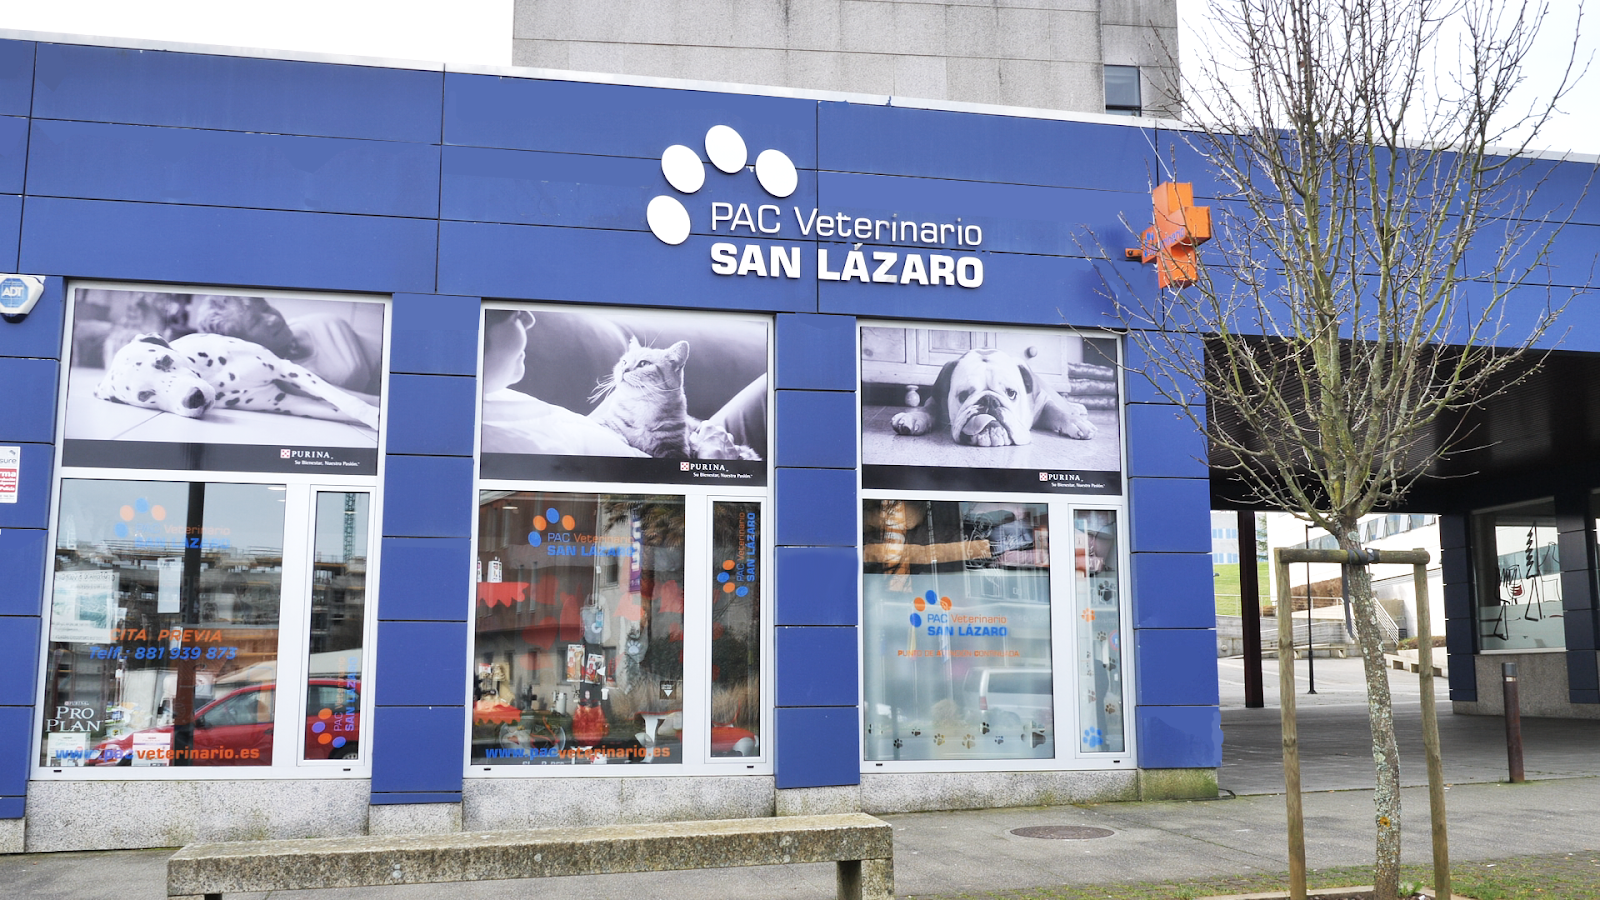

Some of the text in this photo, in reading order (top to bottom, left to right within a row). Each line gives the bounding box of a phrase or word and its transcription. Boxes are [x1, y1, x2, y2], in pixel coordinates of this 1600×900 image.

[711, 202, 983, 247] PAC Veterinario
[711, 242, 984, 288] SAN LÁZARO
[2, 286, 23, 297] ADT
[291, 450, 330, 458] PURINA
[690, 463, 725, 471] PURINA
[1048, 473, 1080, 481] PURINA
[164, 524, 231, 536] Veterinario
[134, 537, 166, 548] SAN
[547, 532, 635, 544] PAC Veterinario
[547, 543, 636, 557] SAN LÁZARO
[736, 511, 746, 582] PAC Veterinario
[745, 512, 756, 582] SAN LÁZARO
[927, 613, 1007, 624] PAC Veterinario
[109, 628, 223, 642] CITA PREVIA
[927, 624, 1007, 636] SAN LÁZARO
[134, 646, 165, 660] 881
[169, 646, 202, 660] 939
[206, 646, 238, 660] 873
[897, 649, 922, 657] PUNTO
[924, 649, 934, 657] DE
[56, 705, 95, 719] PRO
[345, 706, 356, 732] SAN
[45, 718, 102, 732] PLAN
[333, 712, 344, 732] PAC
[485, 745, 671, 760] www.pacveterinario.es
